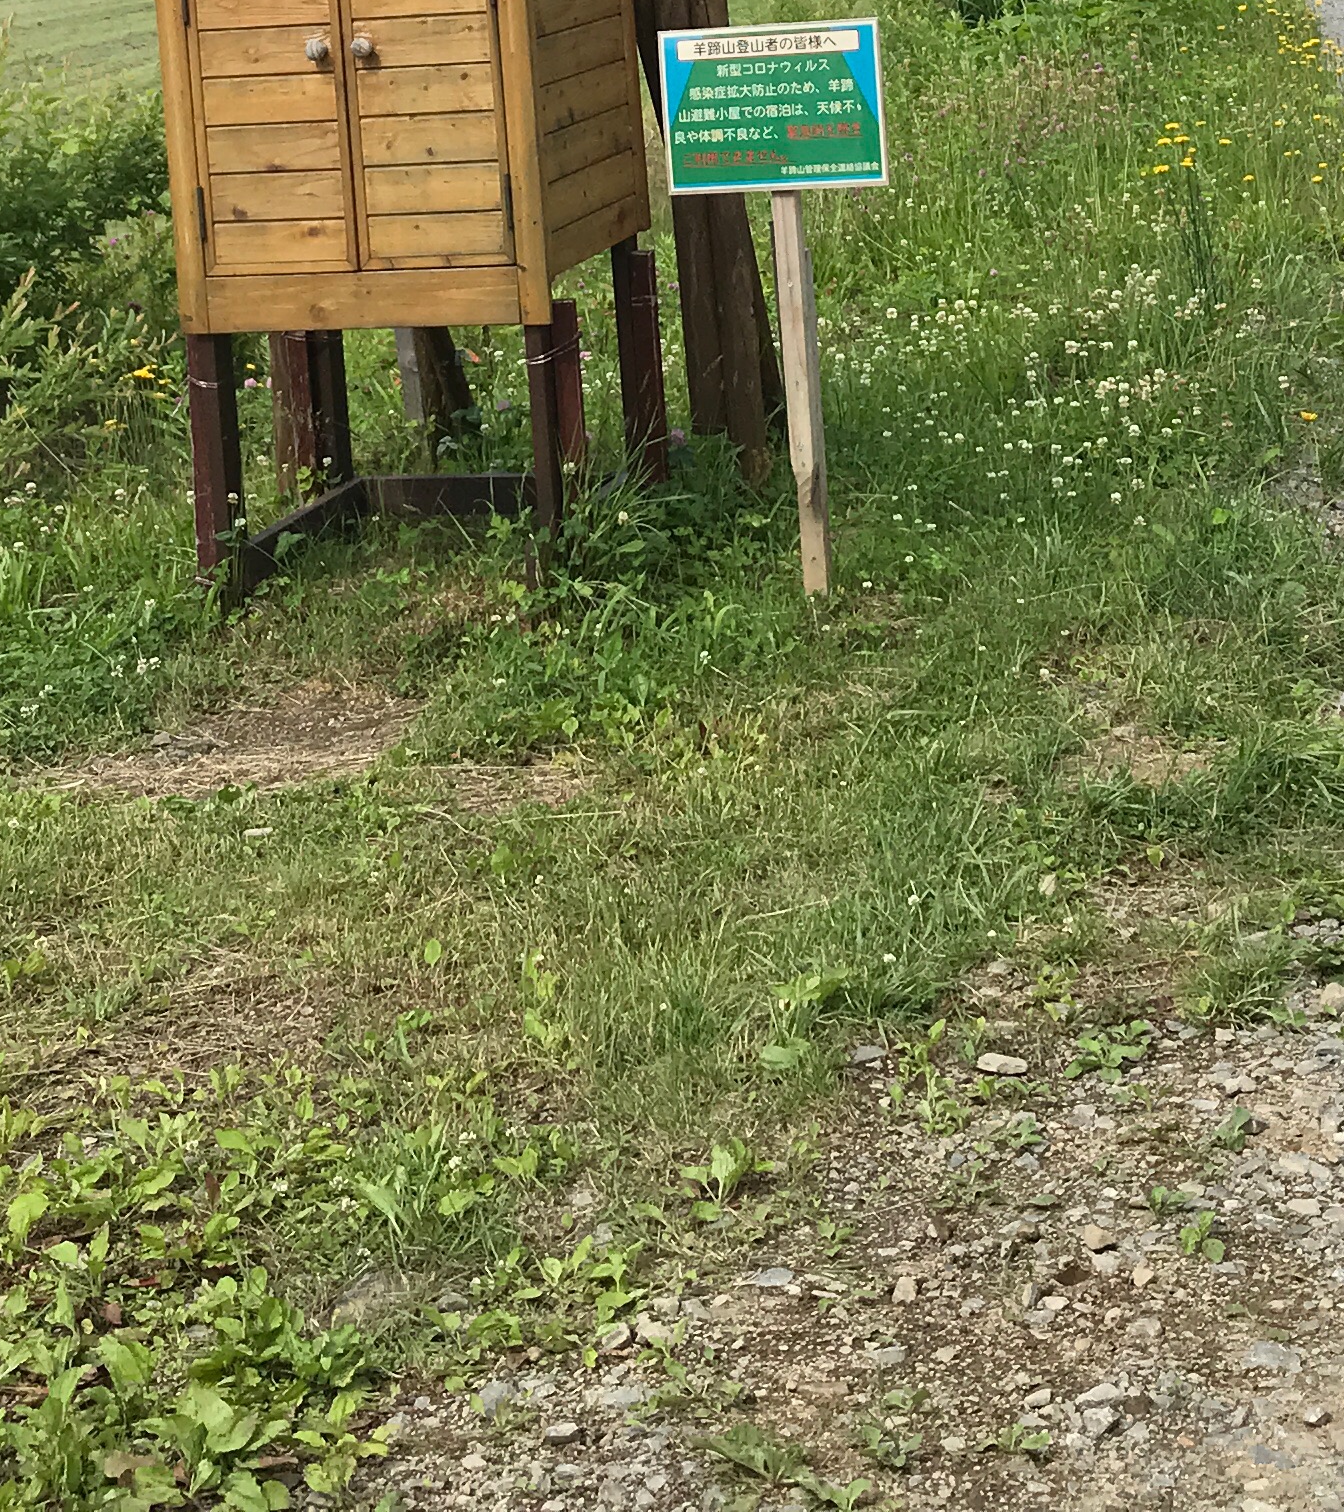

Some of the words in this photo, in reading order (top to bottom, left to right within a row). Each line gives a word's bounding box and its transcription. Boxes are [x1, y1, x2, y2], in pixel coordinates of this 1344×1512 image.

[693, 35, 837, 56] 羊蹄山登山者の皆様へ
[716, 58, 830, 78] 新型コロナウィルス
